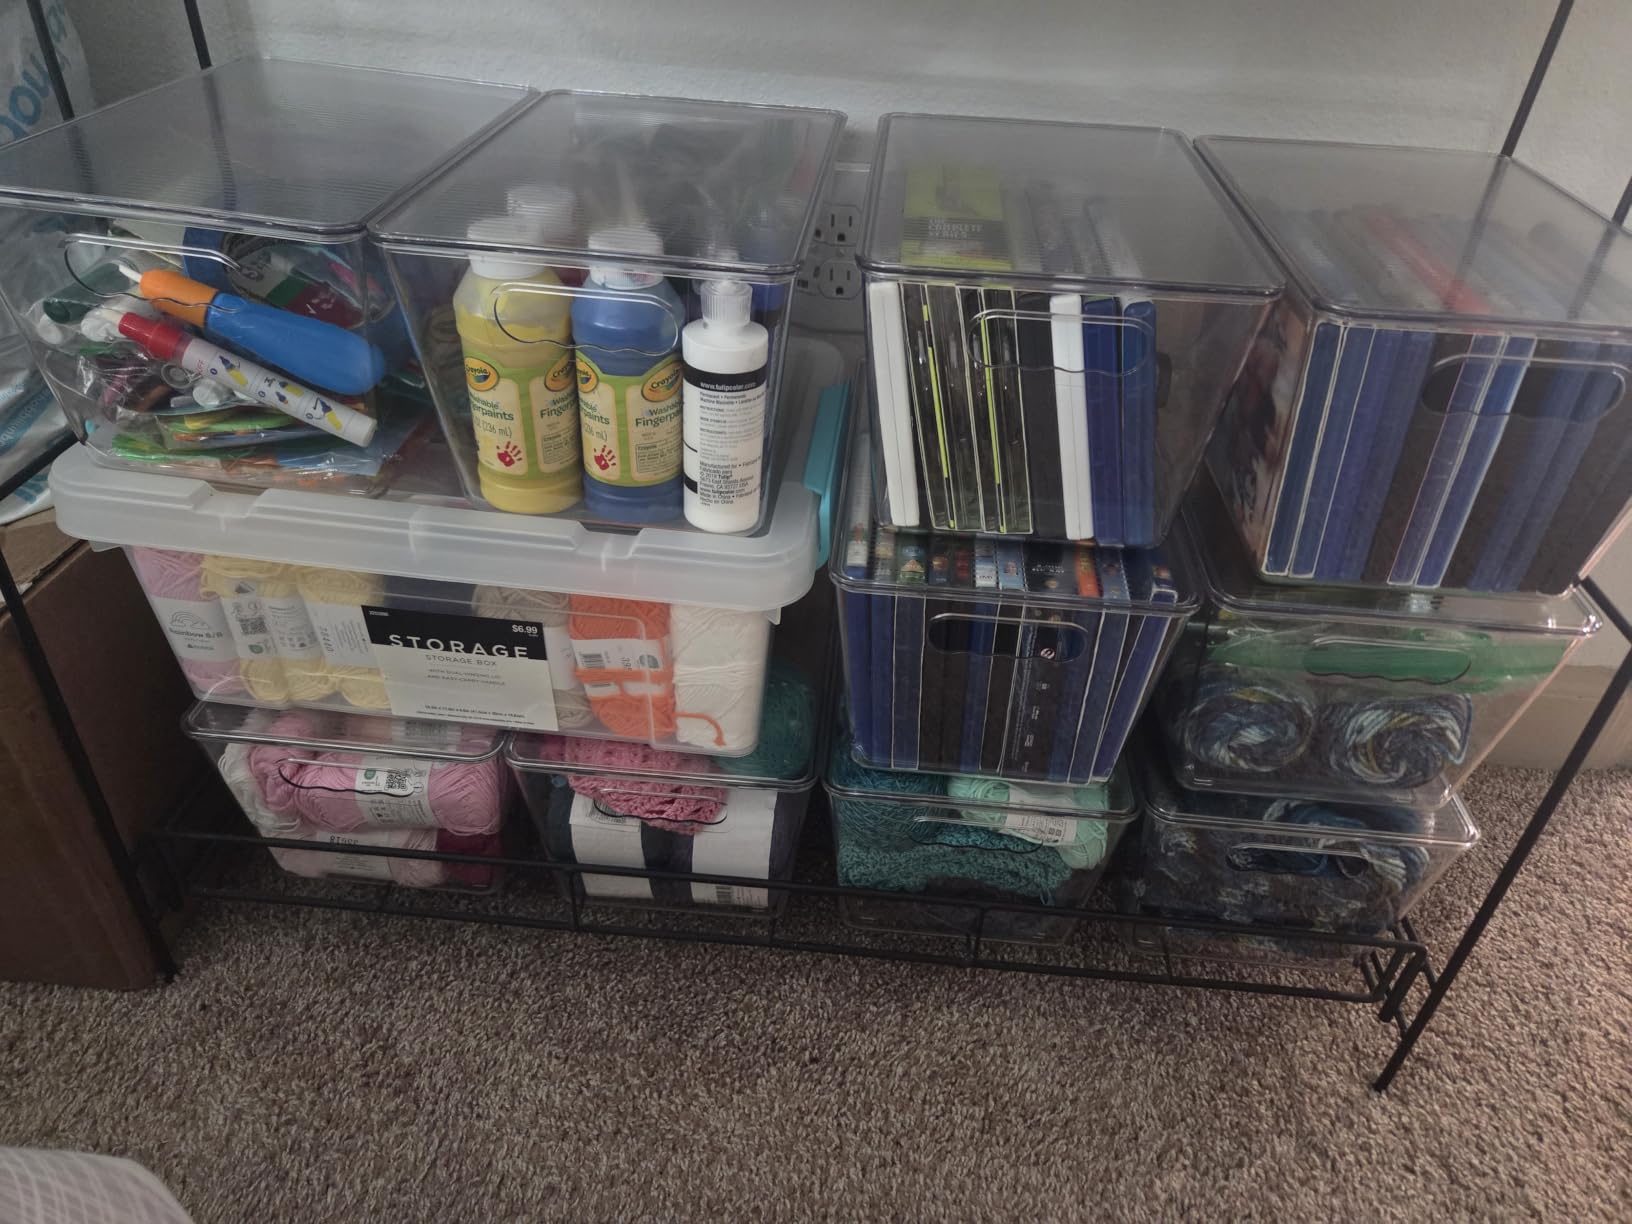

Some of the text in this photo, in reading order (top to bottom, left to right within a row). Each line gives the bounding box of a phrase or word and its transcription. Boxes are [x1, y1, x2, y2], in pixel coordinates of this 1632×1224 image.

[512, 624, 538, 634] $6.99
[389, 633, 529, 660] STORAGE
[425, 654, 497, 667] STORAGE BOX
